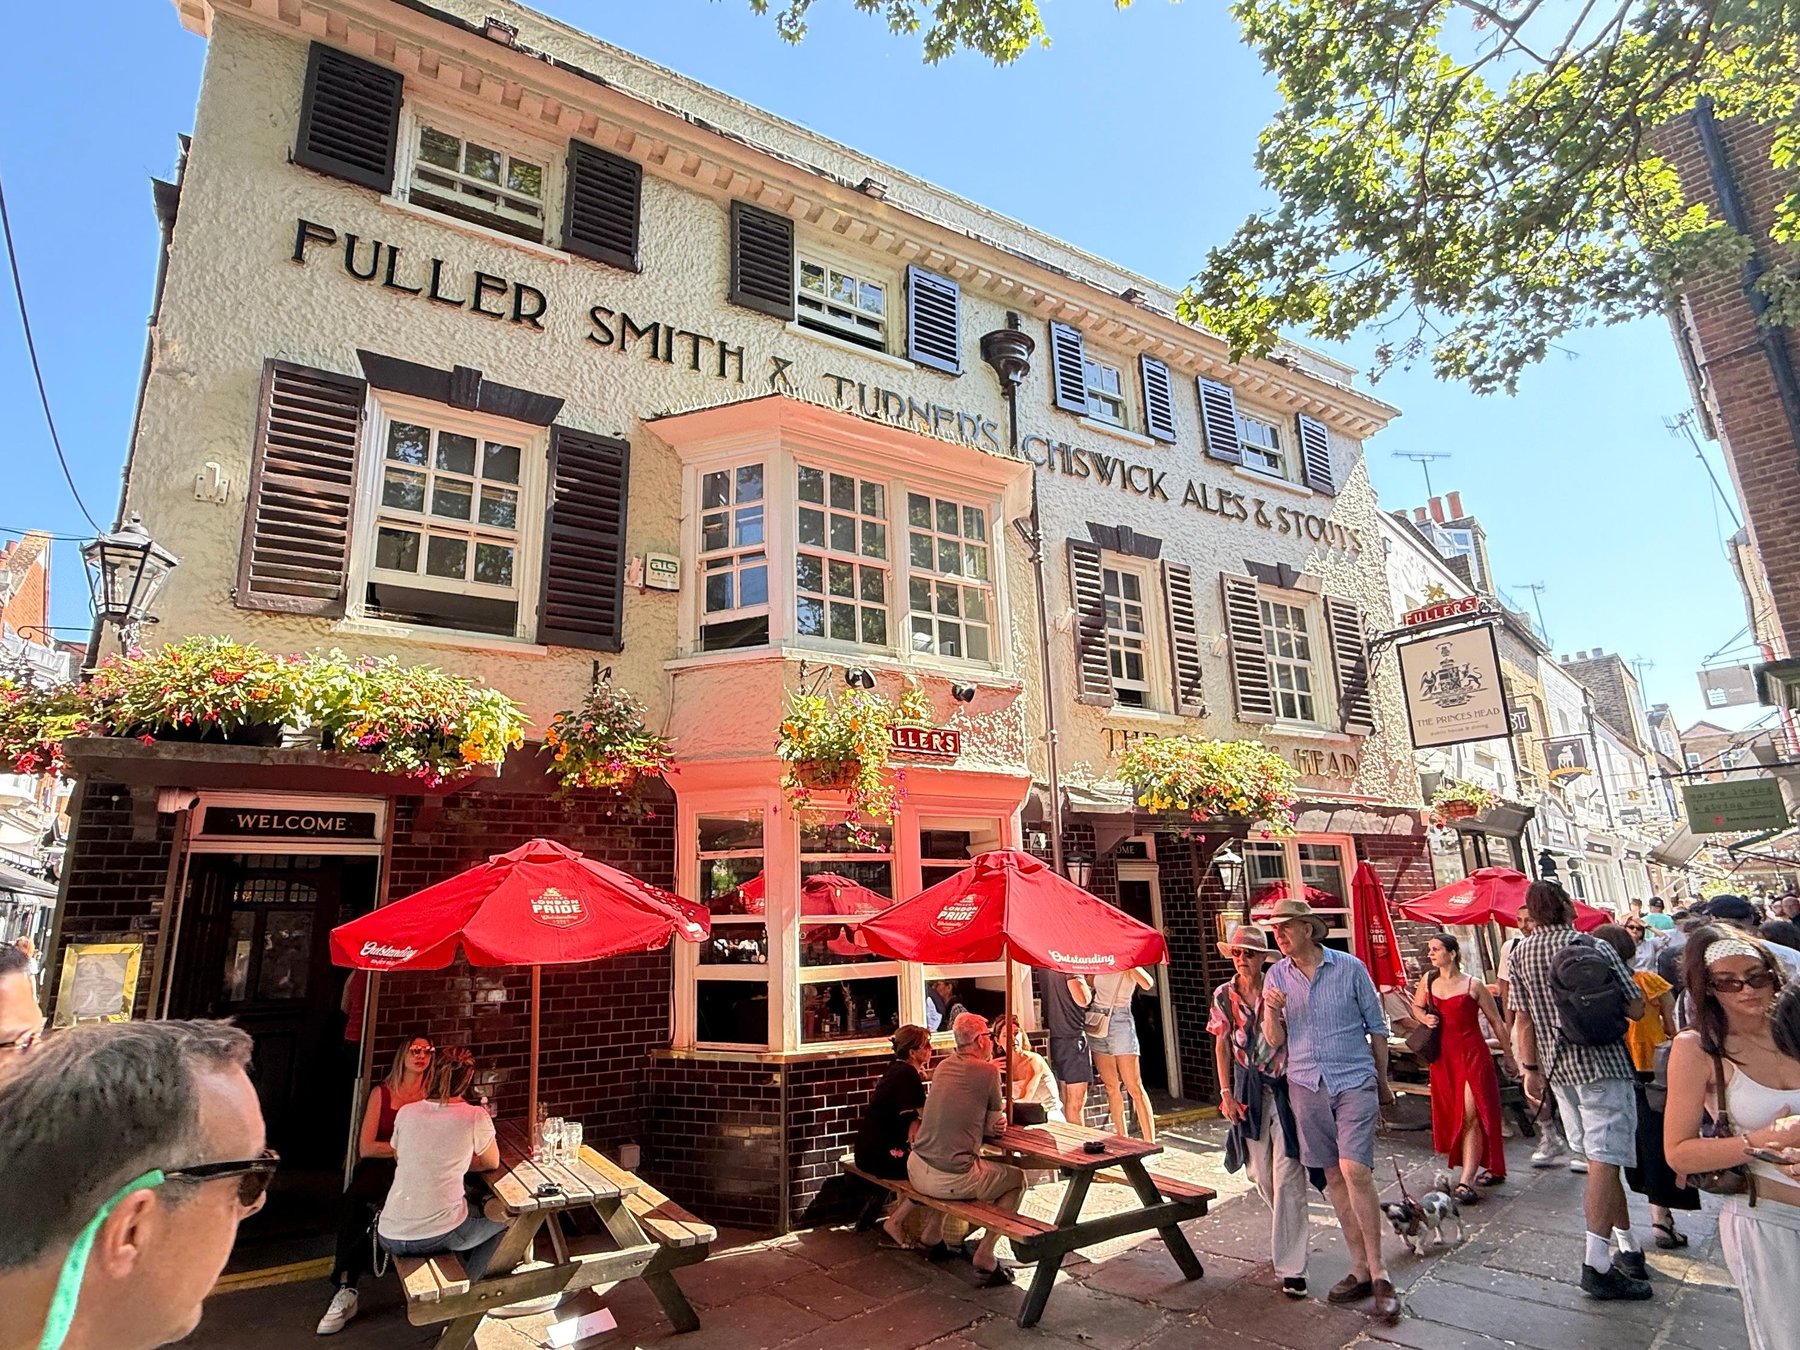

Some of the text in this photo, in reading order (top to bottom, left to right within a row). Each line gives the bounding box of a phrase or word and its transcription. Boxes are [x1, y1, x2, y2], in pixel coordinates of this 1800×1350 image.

[292, 218, 547, 329] FULLER
[587, 307, 744, 383] SMITH
[1022, 434, 1169, 501] CHISWICK
[1181, 479, 1249, 522] ALES
[1253, 501, 1272, 529] &
[1277, 506, 1363, 552] STOUTS
[1404, 600, 1474, 625] FULLER'S
[1416, 707, 1500, 727] THE PRINCES HEAD
[888, 729, 955, 752] LLER'S
[1294, 748, 1357, 778] HEAD
[237, 814, 347, 831] WELCOME
[532, 905, 582, 914] PRIDE
[936, 910, 976, 921] PRIDE
[360, 941, 418, 962] Outstanding
[1048, 949, 1116, 966] Outstanding
